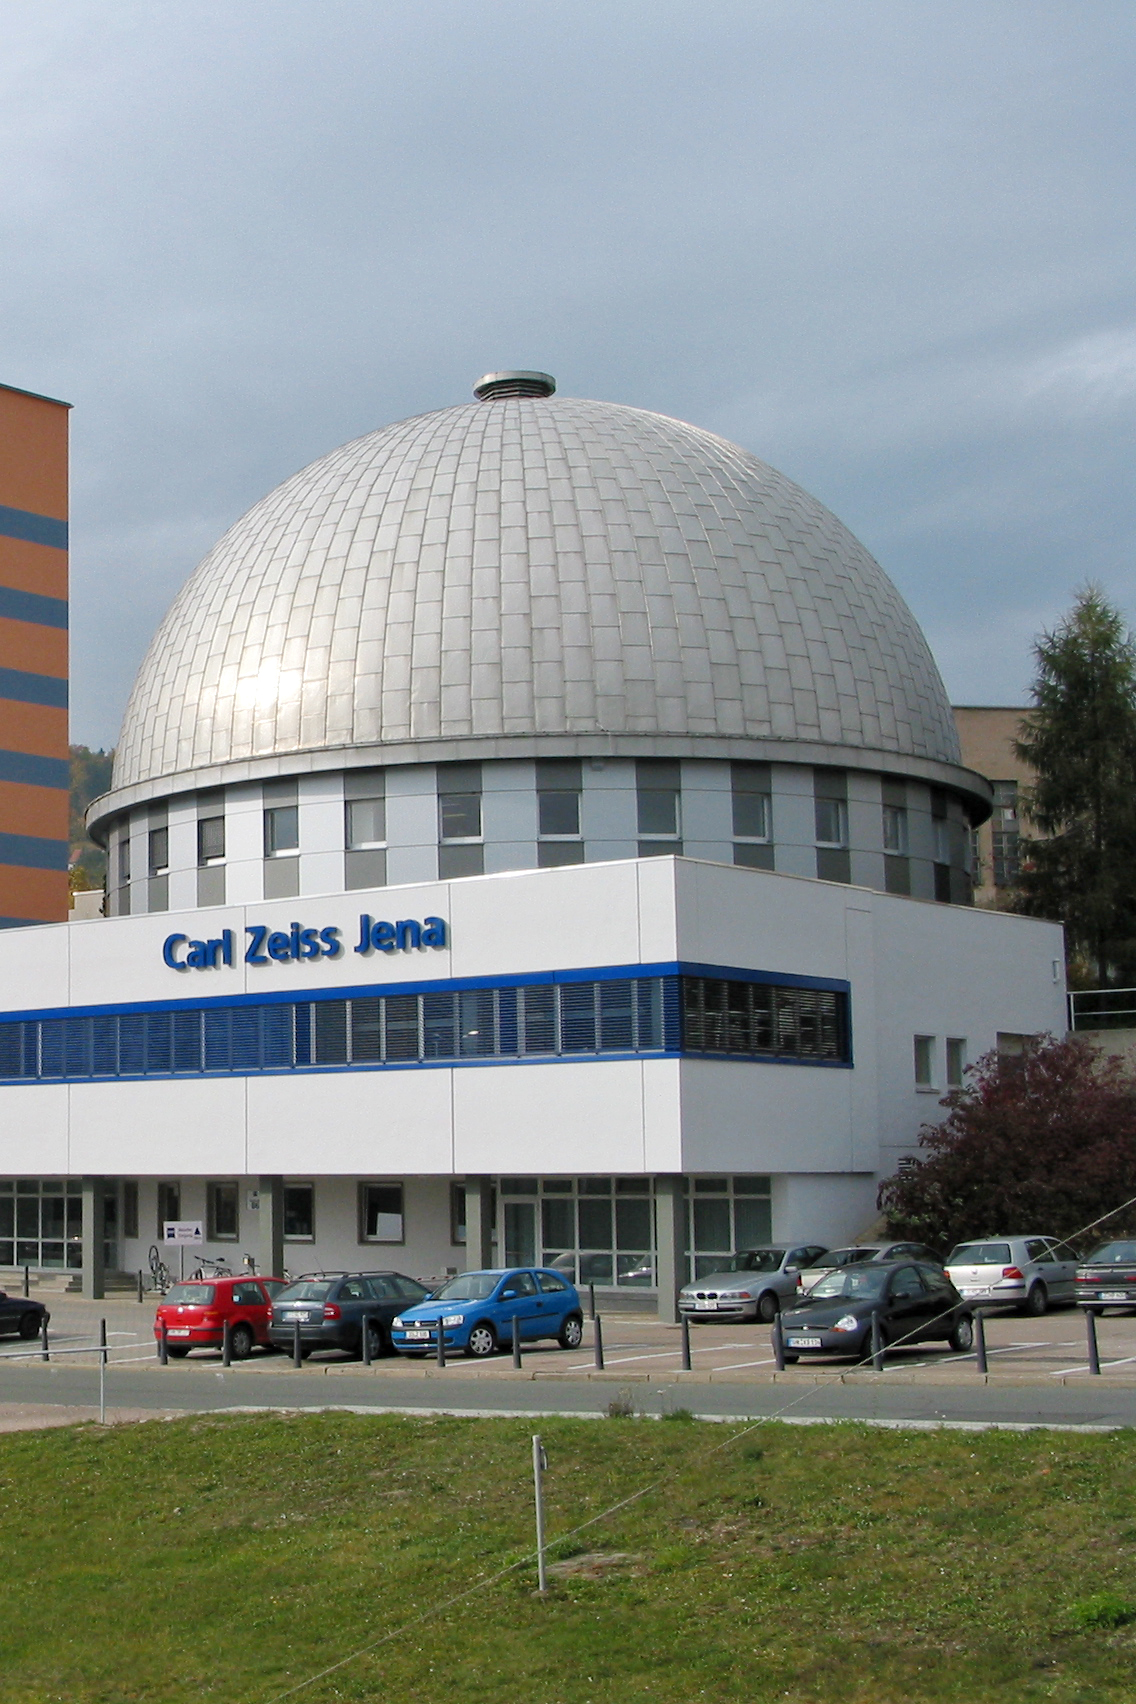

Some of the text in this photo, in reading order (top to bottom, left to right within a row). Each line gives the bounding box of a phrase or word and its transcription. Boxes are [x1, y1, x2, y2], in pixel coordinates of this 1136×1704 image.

[163, 914, 447, 970] Carl Zeiss Jena
